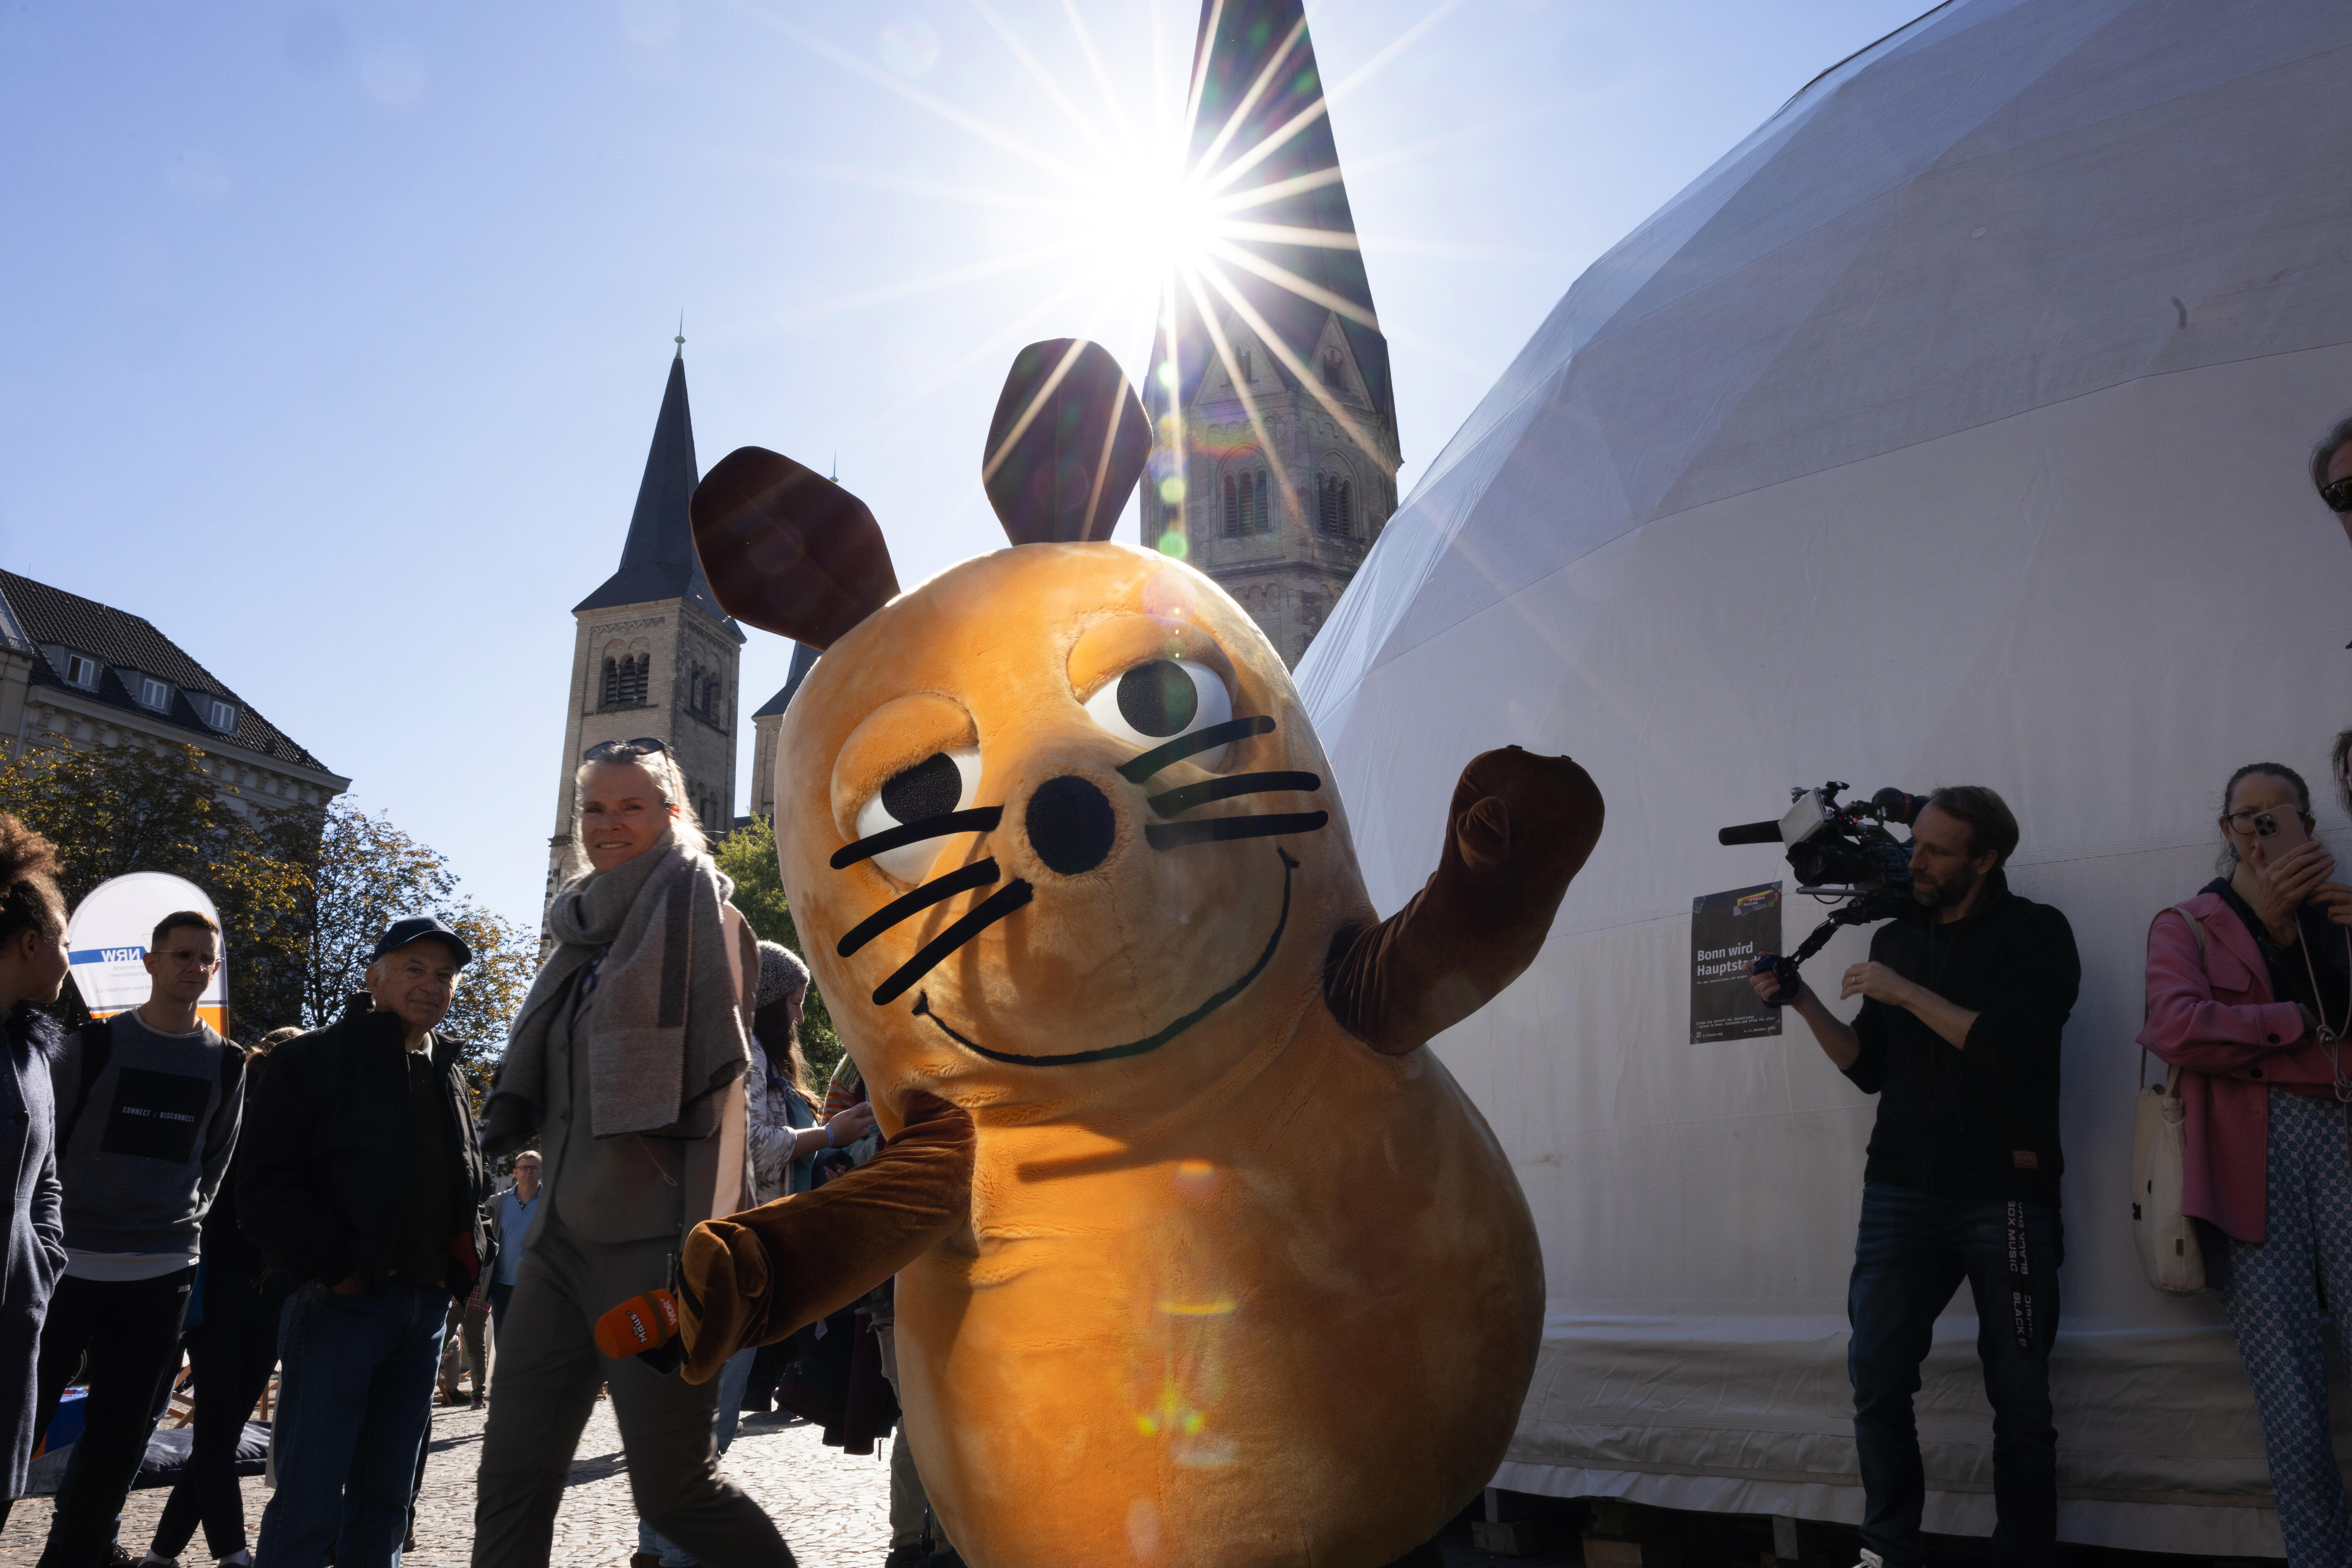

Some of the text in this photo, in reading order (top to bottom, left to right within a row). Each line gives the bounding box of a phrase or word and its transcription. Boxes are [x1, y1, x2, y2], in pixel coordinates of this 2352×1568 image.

[1698, 941, 1753, 961] Bonn wird
[122, 1106, 151, 1117] CONNECT
[159, 1112, 195, 1122] DISCONNECT
[2008, 1229, 2018, 1272] MUSIC
[2019, 1231, 2028, 1275] BLACK
[178, 1284, 190, 1293] JAKO
[2013, 1292, 2025, 1334] BLACK
